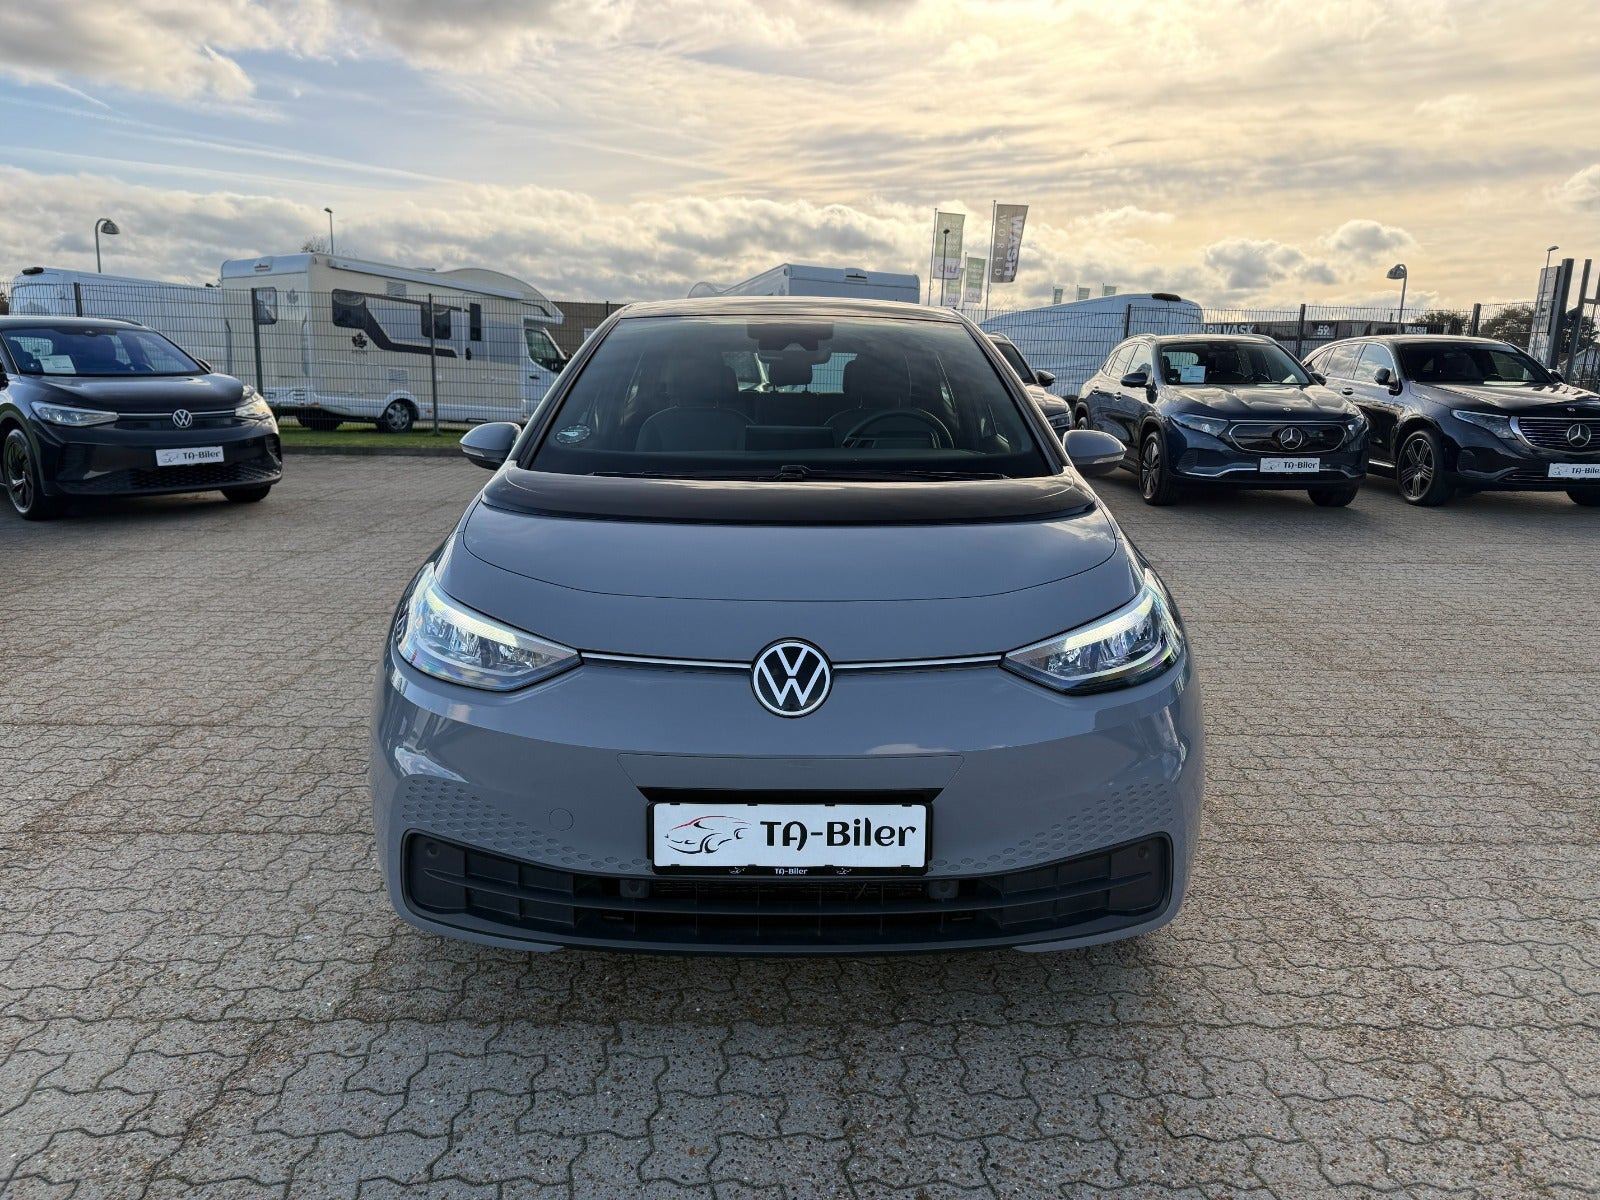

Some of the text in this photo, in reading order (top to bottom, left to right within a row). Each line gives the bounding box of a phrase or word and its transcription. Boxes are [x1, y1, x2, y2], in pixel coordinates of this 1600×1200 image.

[995, 214, 1008, 276] WORLD
[1004, 215, 1024, 276] WASH
[1224, 324, 1254, 335] VASK
[183, 450, 220, 460] TA-Biler
[1283, 461, 1318, 469] TA-Biler
[760, 817, 917, 851] TA-Biler
[774, 867, 808, 876] TA-Biler
